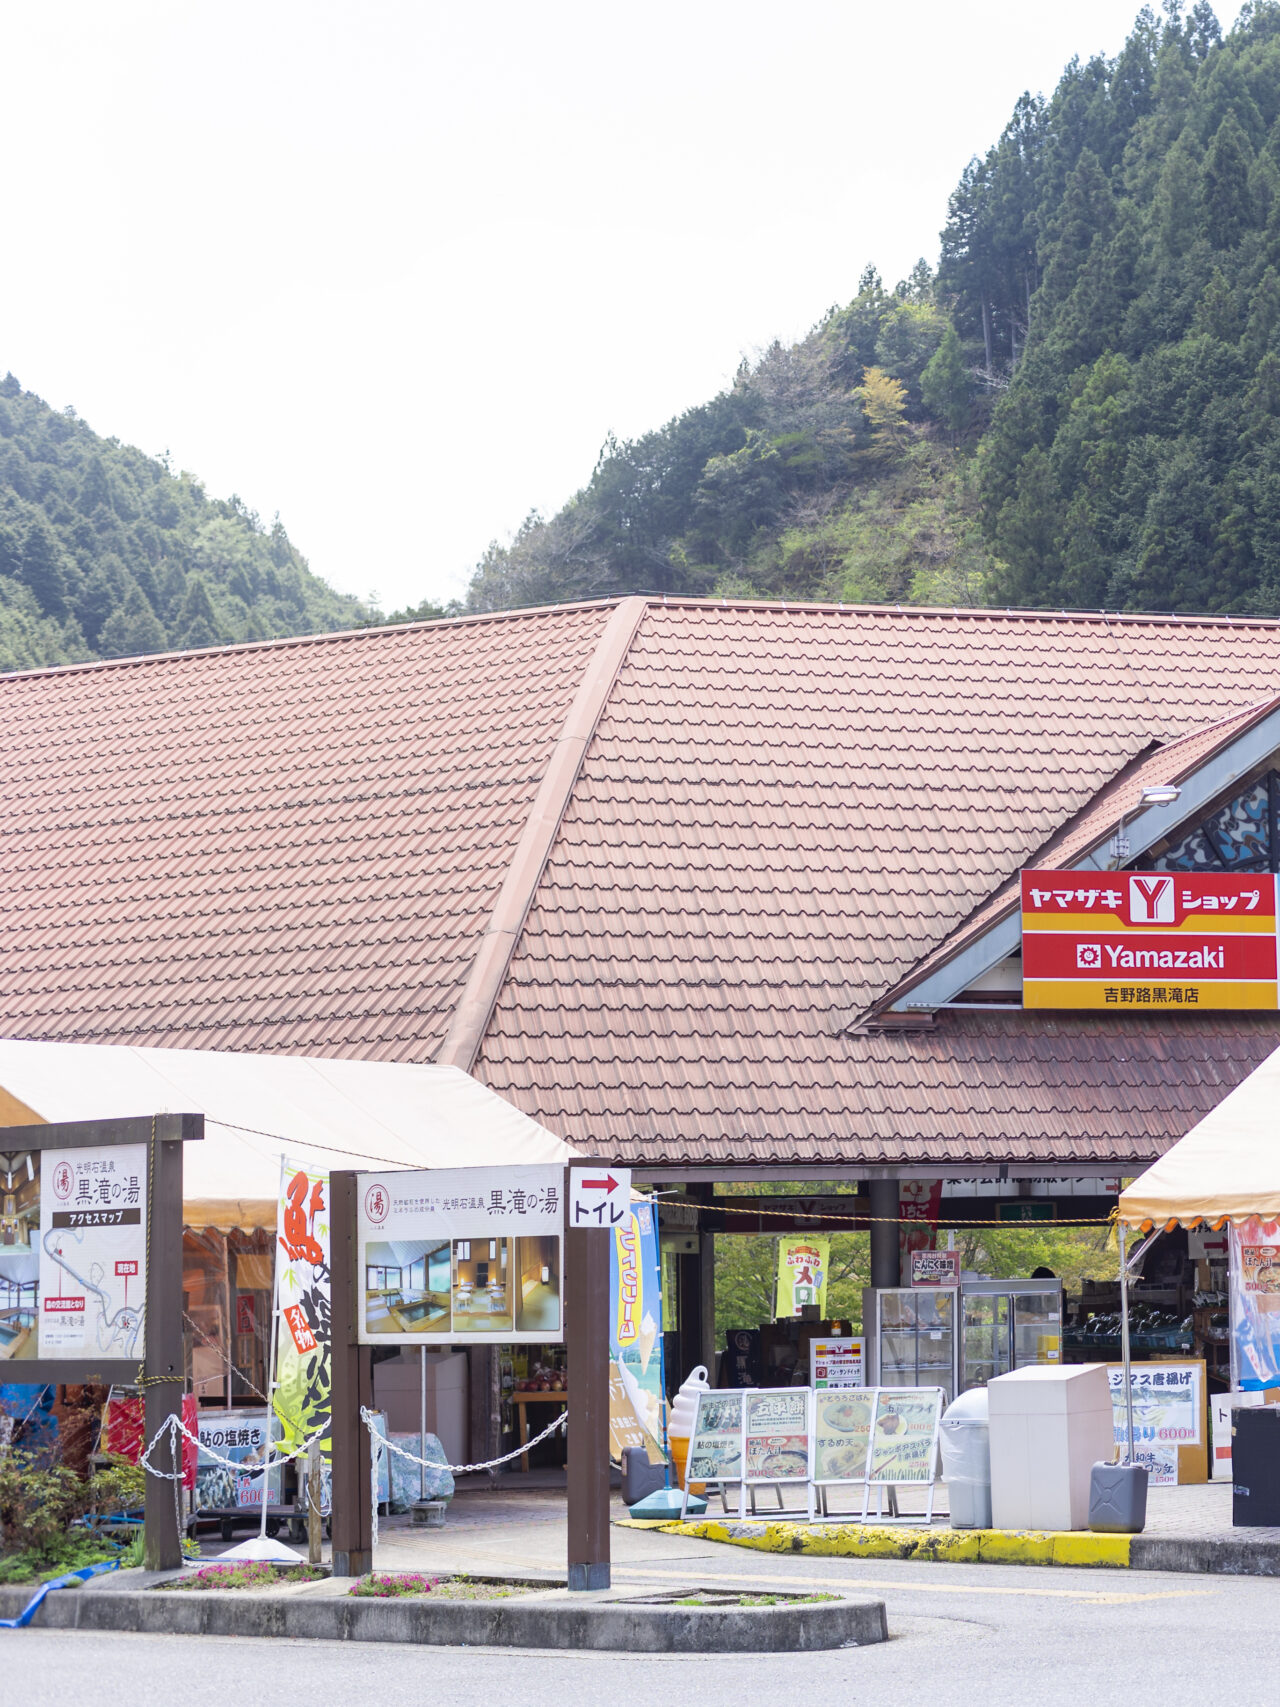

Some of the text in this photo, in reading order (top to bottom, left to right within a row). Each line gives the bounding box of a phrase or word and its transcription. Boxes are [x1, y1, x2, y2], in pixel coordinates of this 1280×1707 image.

[1030, 879, 1260, 919] ヤマザキ Y ショップ
[1104, 945, 1224, 968] Yamazaki
[1104, 987, 1199, 1003] 吉野路黒滝店
[57, 1168, 70, 1193] 湯
[75, 1176, 140, 1205] 黒滝の湯
[370, 1191, 384, 1216] 湯
[487, 1187, 559, 1216] 黒滝の湯
[575, 1200, 625, 1224] トイレ
[70, 1211, 123, 1225] アクセスマップ
[289, 1307, 315, 1352] 名物
[1107, 1371, 1192, 1386] ジマス唐揚げ
[199, 1429, 261, 1447] 鮎の塩焼き
[1159, 1428, 1195, 1440] 600円
